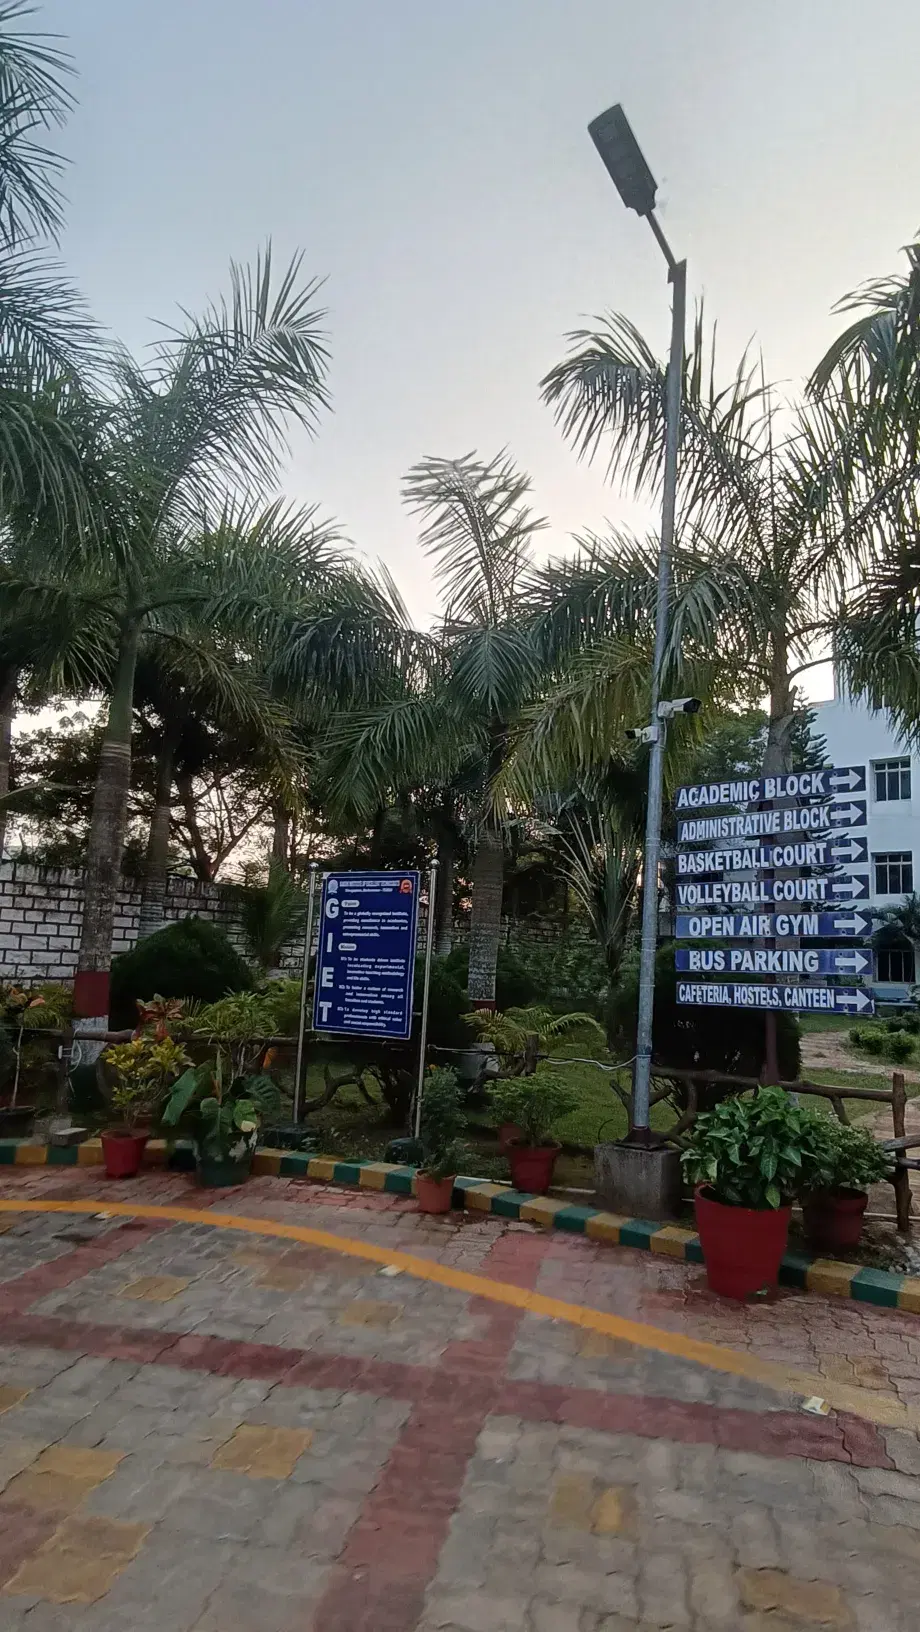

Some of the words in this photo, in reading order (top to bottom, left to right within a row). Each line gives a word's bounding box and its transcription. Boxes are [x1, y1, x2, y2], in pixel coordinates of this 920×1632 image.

[677, 780, 760, 808] ACADEMIC
[764, 773, 825, 798] BLOCK
[681, 811, 780, 842] ADMINISTRATIVE
[784, 806, 830, 831] BLOCK
[678, 848, 769, 873] BASKETBALL
[773, 843, 827, 867] COURT
[678, 881, 769, 904] VOLLEYBALL
[773, 878, 828, 901] COURT
[689, 917, 735, 936] OPEN
[739, 916, 770, 936] AIR
[776, 915, 819, 935] GYM
[689, 951, 726, 971] BUS
[731, 950, 819, 972] PARKING
[679, 985, 731, 1004] CAFETERIA,
[784, 988, 835, 1008] CANTEEN
